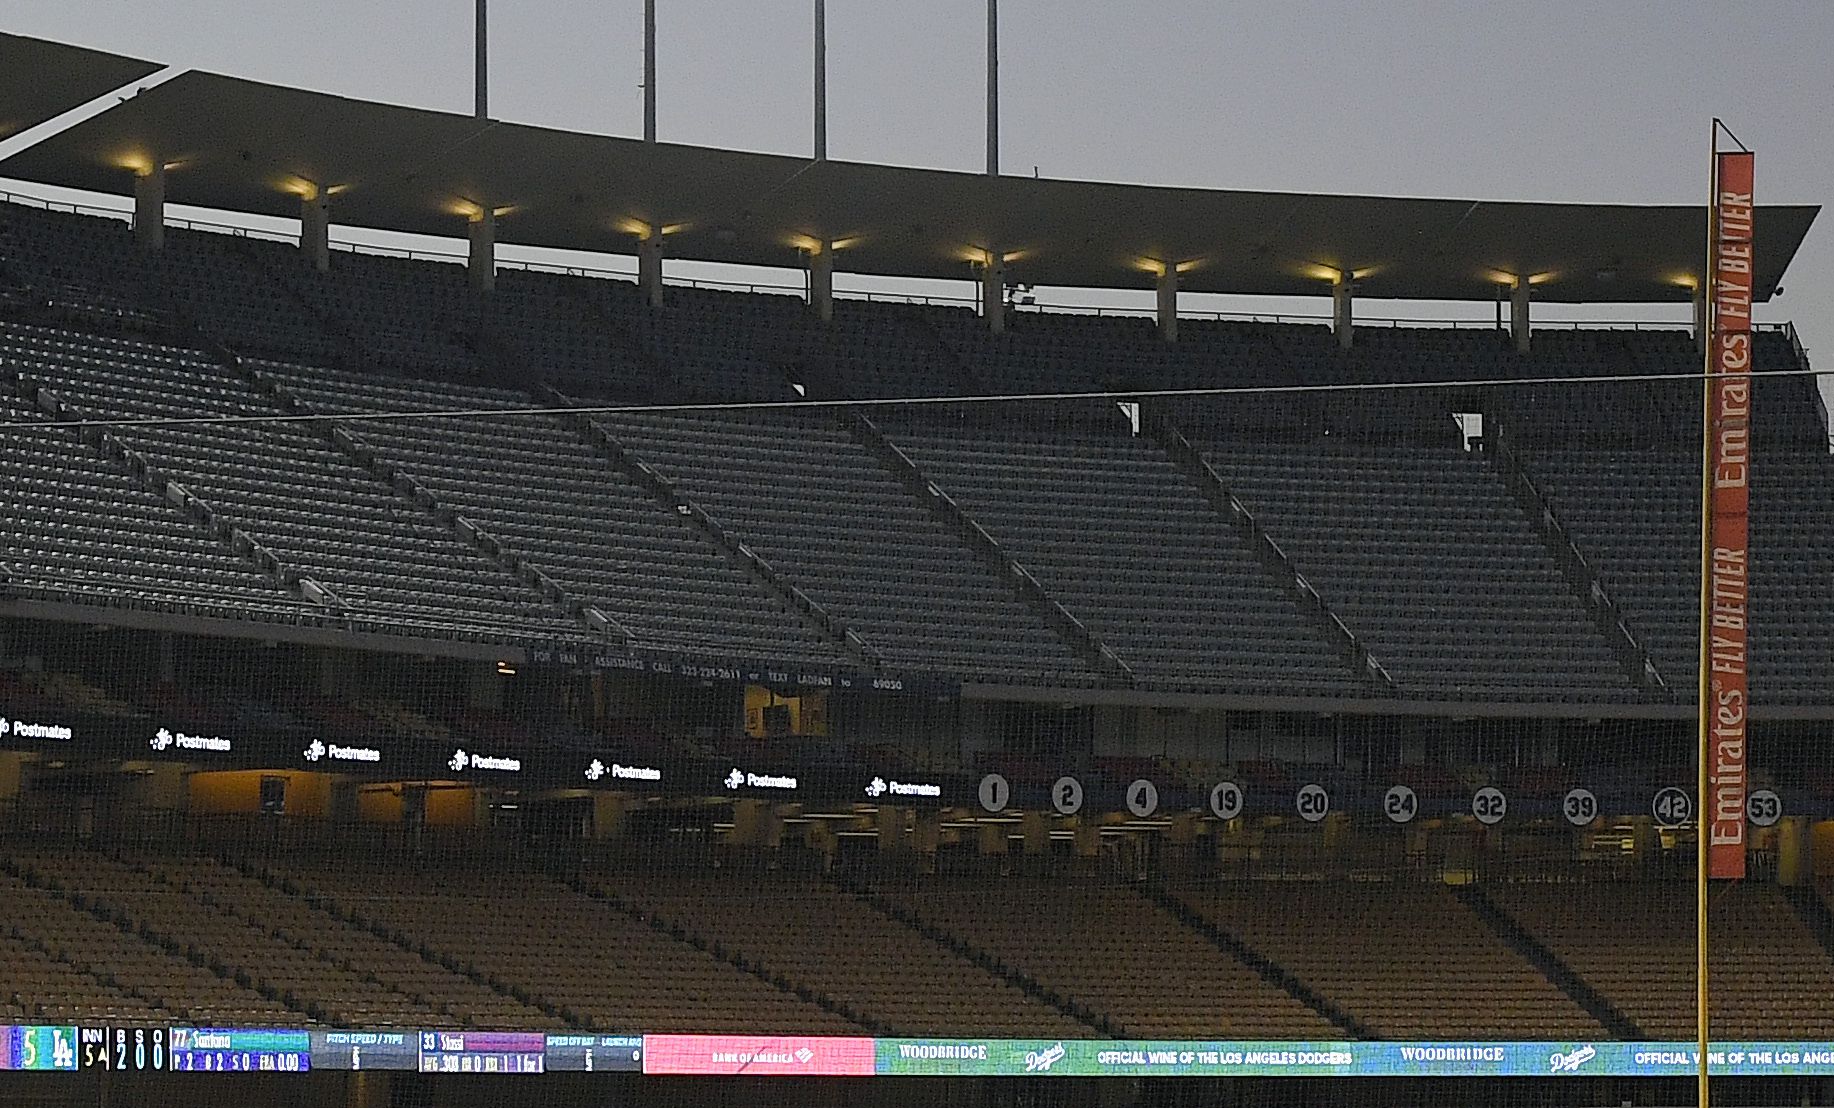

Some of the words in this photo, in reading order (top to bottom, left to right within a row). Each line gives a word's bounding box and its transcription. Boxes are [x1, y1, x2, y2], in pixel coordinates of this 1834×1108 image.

[1719, 191, 1751, 274] BETTER
[1718, 278, 1749, 319] FLY
[1716, 332, 1748, 489] Emirates
[1712, 547, 1745, 632] BETTER
[1712, 635, 1745, 674] FLY
[653, 662, 672, 673] CALL
[14, 721, 72, 741] Postmates
[176, 733, 231, 752] Postmates
[329, 744, 380, 762] Postmates
[1710, 688, 1744, 847] Emirates
[990, 782, 999, 803] 1
[1061, 785, 1075, 806] 2
[1134, 787, 1148, 809] 4
[1215, 790, 1237, 811] 19
[1300, 793, 1326, 814] 20
[1388, 793, 1415, 815] 24
[1475, 795, 1505, 816] 32
[1565, 796, 1594, 817] 39
[1657, 796, 1686, 818] 42
[1750, 797, 1779, 819] 53
[83, 1029, 103, 1043] INN
[117, 1029, 126, 1043] B
[136, 1029, 144, 1043] S
[23, 1031, 36, 1065] 5
[85, 1045, 93, 1066] 5
[116, 1044, 127, 1069] 2
[136, 1044, 145, 1069] 0
[153, 1044, 163, 1069] 0
[899, 1044, 987, 1060] WOODBRIDGE
[1097, 1051, 1146, 1065] OFFICIAL
[1148, 1051, 1177, 1065] WINE
[1179, 1051, 1195, 1065] OF
[1197, 1051, 1217, 1065] THE
[1220, 1051, 1243, 1065] LOS
[1245, 1051, 1296, 1065] ANGELES
[1298, 1051, 1352, 1065] DODGERS
[1400, 1047, 1504, 1062] WOODBRIDGE
[1634, 1052, 1690, 1065] OFFICIAL
[1692, 1052, 1725, 1065] WNE
[1728, 1052, 1744, 1065] OF
[1748, 1052, 1772, 1065] THE
[1775, 1052, 1799, 1065] LOS
